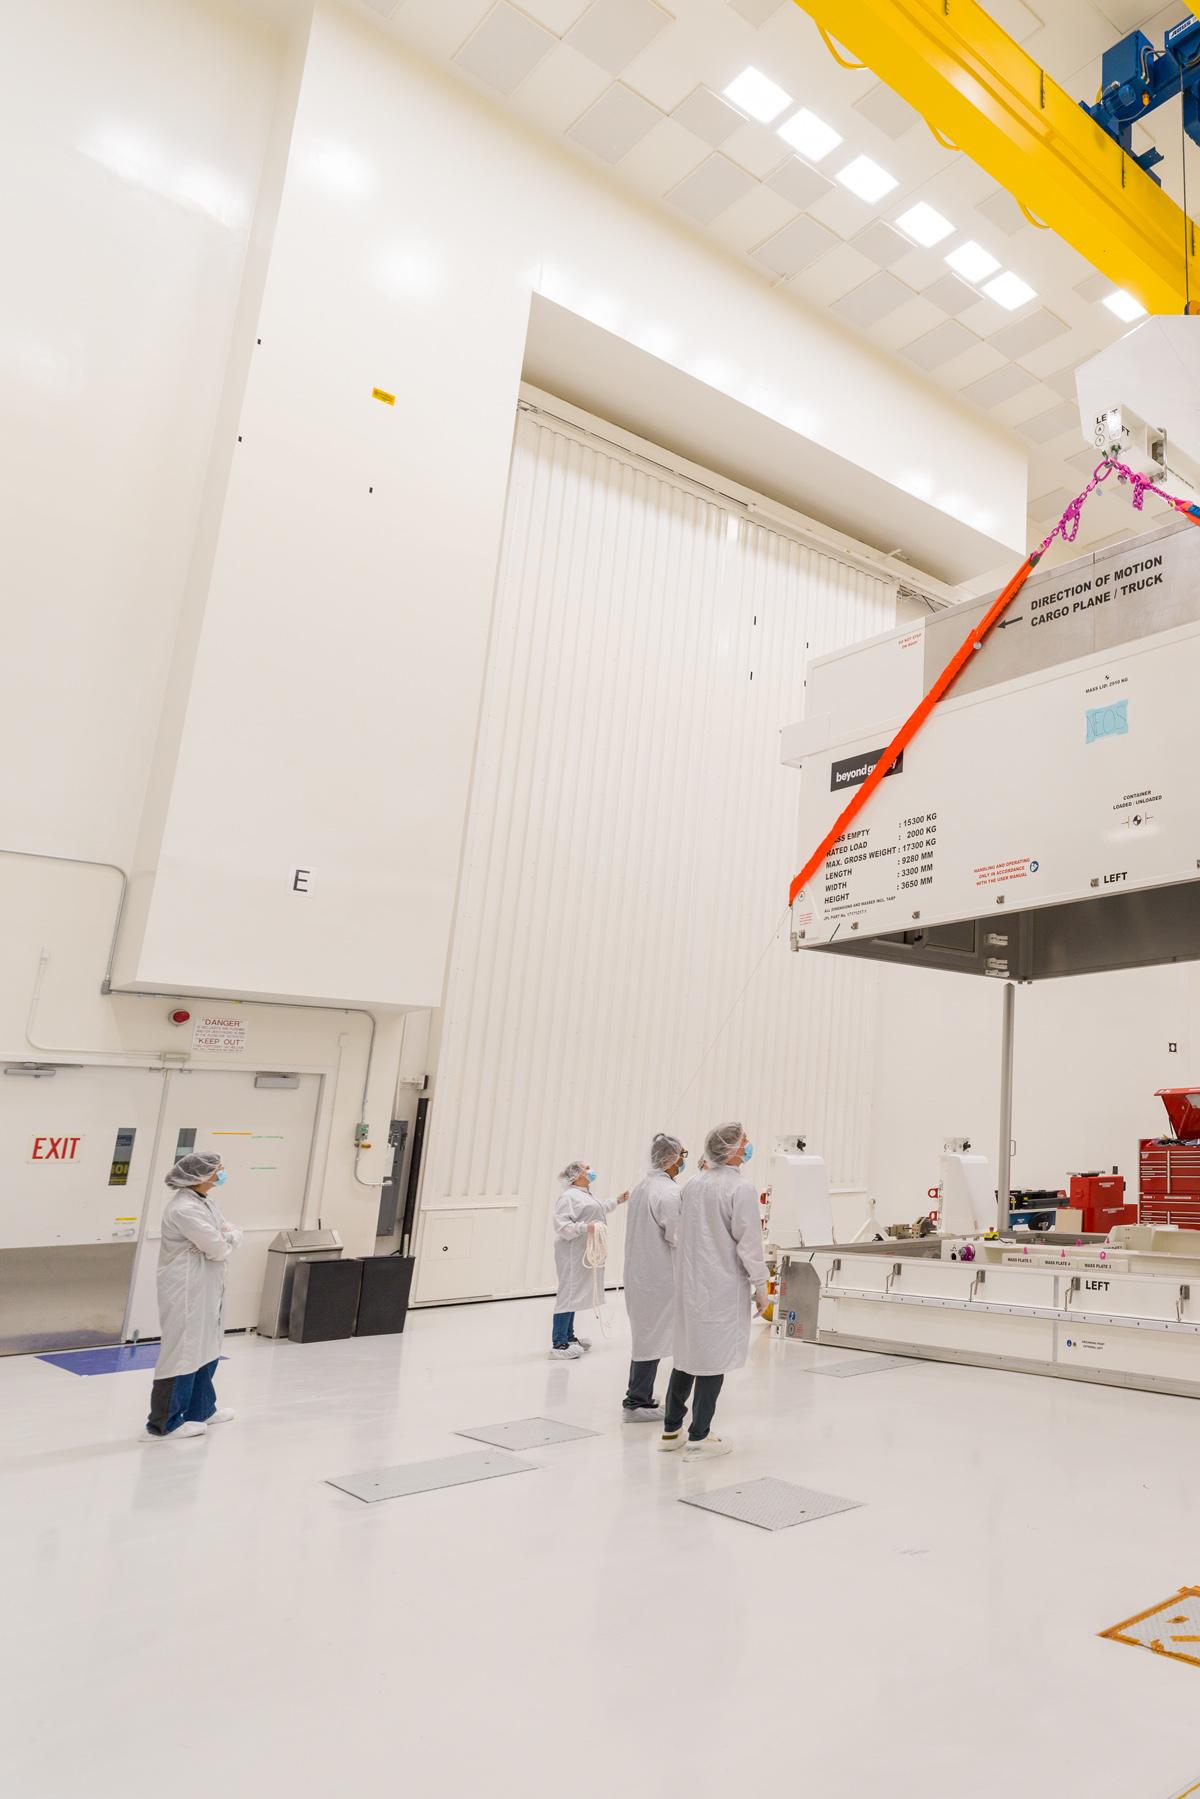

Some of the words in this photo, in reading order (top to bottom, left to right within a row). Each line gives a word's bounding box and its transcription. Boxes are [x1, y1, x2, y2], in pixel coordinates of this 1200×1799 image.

[1096, 408, 1118, 424] LET
[1030, 580, 1092, 610] DIRECTION
[1095, 574, 1110, 588] OF
[1114, 556, 1162, 581] MOTION
[1030, 606, 1070, 627] CARGO
[1073, 592, 1111, 614] PLANE
[1120, 573, 1164, 596] TRUCK
[1086, 704, 1128, 737] NEOS
[836, 764, 868, 783] beyond
[1112, 802, 1132, 810] LOADED
[1135, 795, 1163, 805] UNLOADED
[1123, 790, 1152, 801] CONTAINER
[847, 828, 870, 840] EMPTY
[903, 815, 924, 827] 15300
[926, 812, 937, 822] KG
[826, 846, 848, 858] RATED
[849, 841, 868, 852] LOAD
[906, 828, 924, 839] 2000
[926, 825, 937, 834] KG
[826, 858, 842, 869] MAX.
[844, 852, 867, 865] GROSS
[869, 846, 897, 859] WEIGHT
[902, 841, 924, 852] 17300
[925, 838, 936, 846] KG
[825, 868, 852, 881] LENGTH
[901, 854, 919, 864] 9280
[920, 851, 934, 860] MM
[825, 881, 847, 892] WIDTH
[901, 866, 919, 877] 3300
[920, 863, 933, 872] MM
[974, 865, 996, 873] HANDLING
[1006, 858, 1030, 867] OPERATING
[996, 866, 1025, 875] ACCORDANCE
[1104, 871, 1128, 884] LEFT
[292, 869, 310, 893] E
[824, 893, 850, 904] HEIGHT
[901, 879, 919, 890] 3650
[920, 876, 933, 886] MM
[32, 1138, 80, 1160] EXIT
[1085, 1280, 1110, 1291] LEFT
